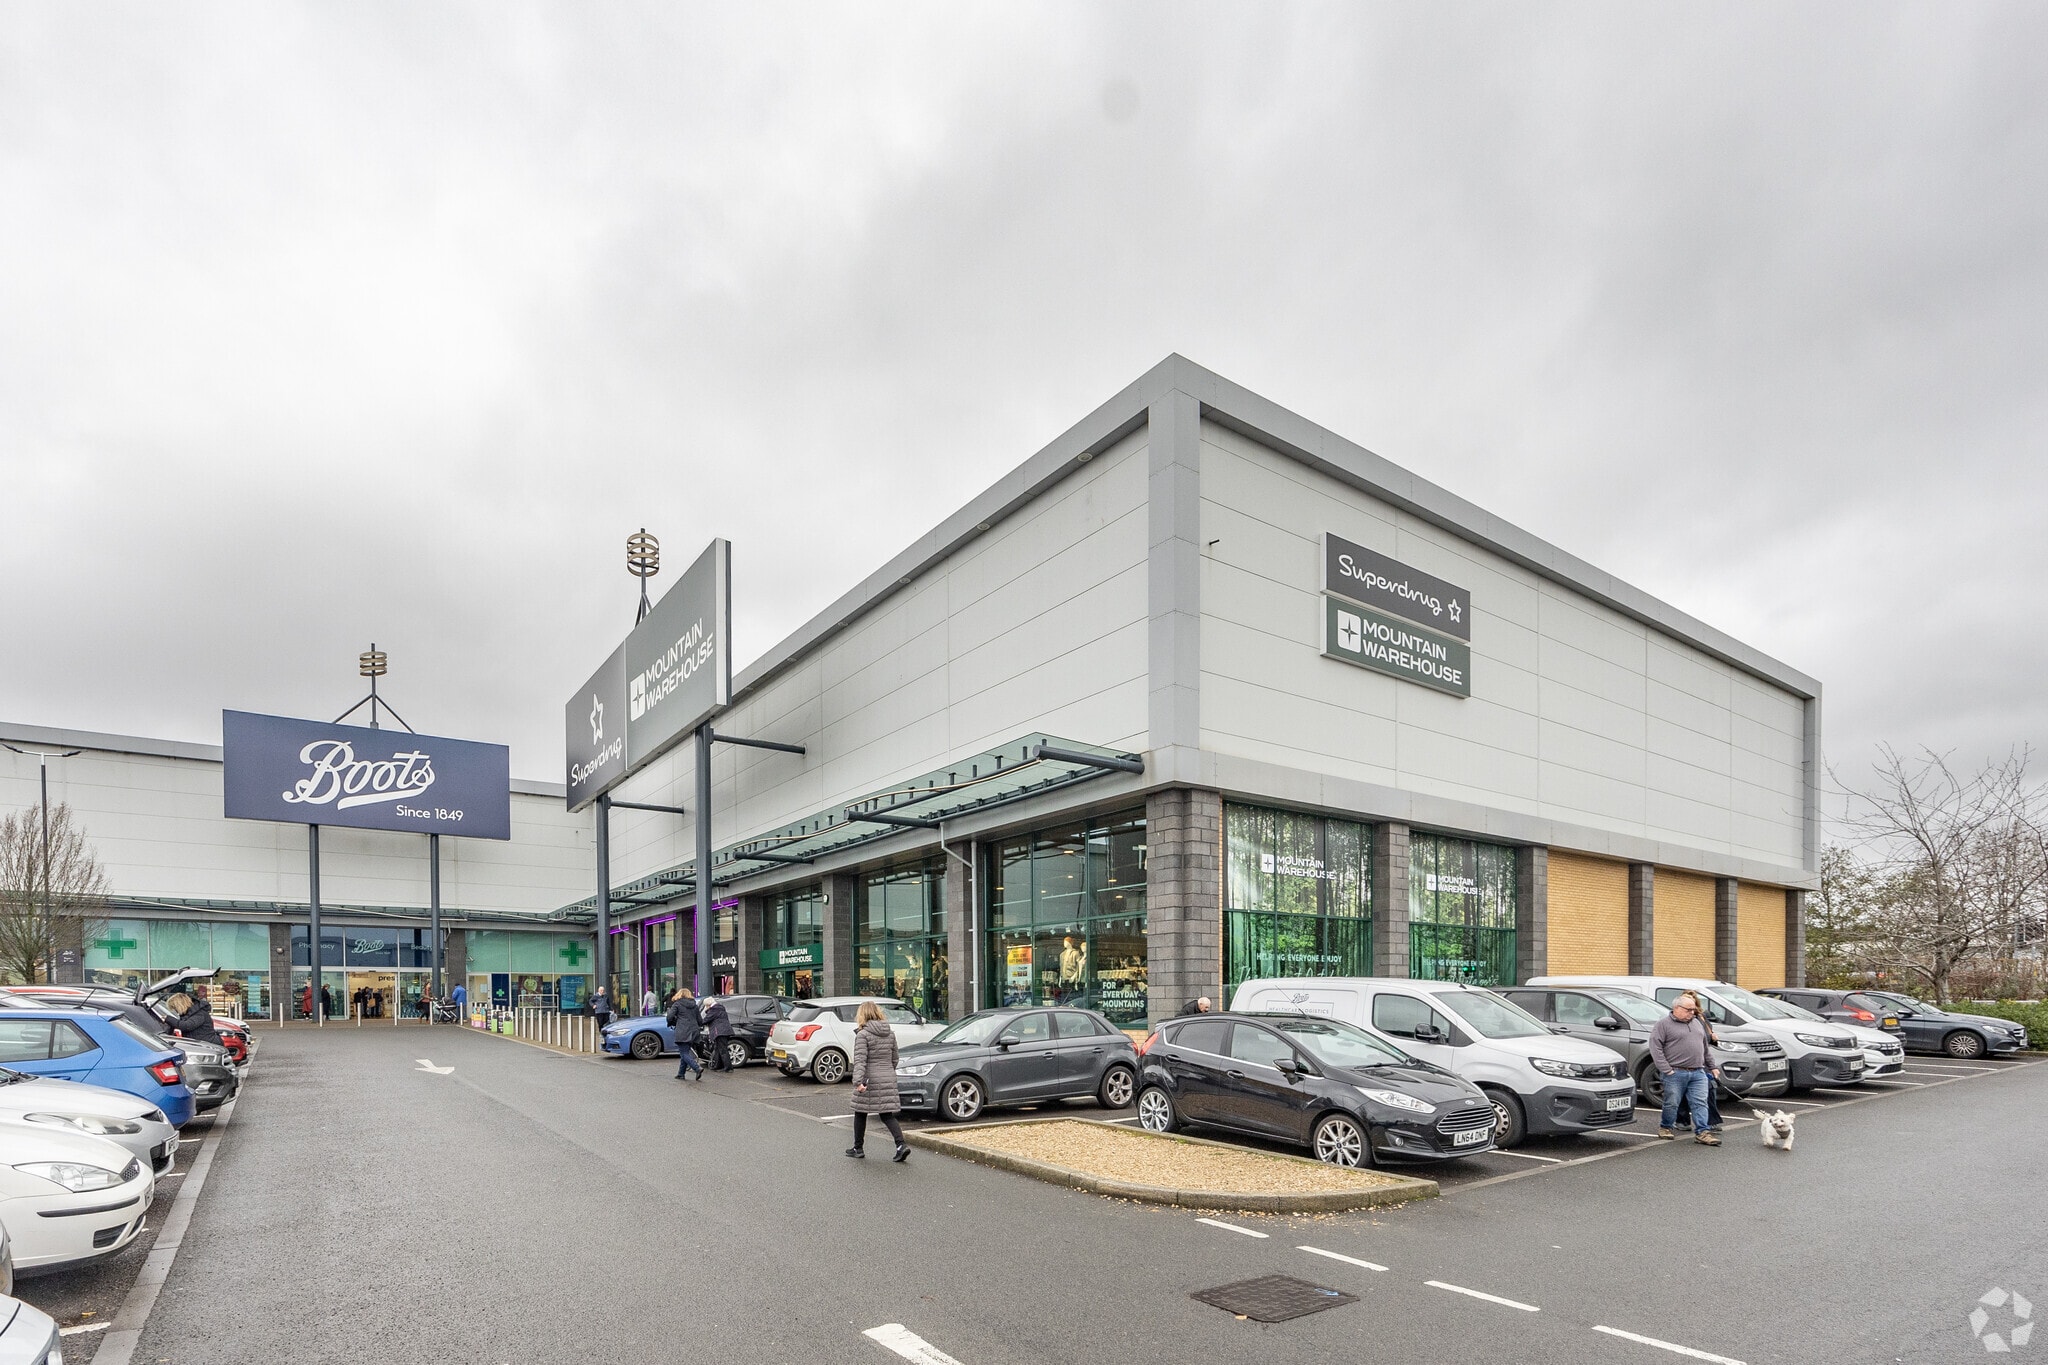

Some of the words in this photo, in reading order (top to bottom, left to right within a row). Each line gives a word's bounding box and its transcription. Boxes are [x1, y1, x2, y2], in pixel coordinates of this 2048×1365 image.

[1338, 554, 1442, 616] Superdrug
[1363, 619, 1447, 661] MOUNTAIN
[645, 617, 703, 687] MOUNTAIN
[1362, 639, 1462, 685] WAREHOUSE
[645, 632, 714, 710] WAREHOUSE
[571, 737, 622, 787] Superdrug
[282, 740, 436, 811] Boots
[396, 805, 431, 819] Since
[434, 808, 464, 822] 1849
[1276, 855, 1325, 869] MOUNTAIN
[1276, 865, 1337, 880] WAREHOUSE
[1437, 875, 1474, 887] MOUNTAIN
[299, 942, 335, 951] Phaacy
[351, 939, 384, 954] Boots
[784, 947, 808, 957] MOUNTAIN
[1256, 953, 1286, 962] HELPNG
[1288, 953, 1320, 963] EVERYONE
[1102, 981, 1117, 990] FOR
[1102, 990, 1139, 999] EVERYDAY
[1102, 1000, 1145, 1008] MOUNTAINS
[1456, 1131, 1474, 1144] LN64
